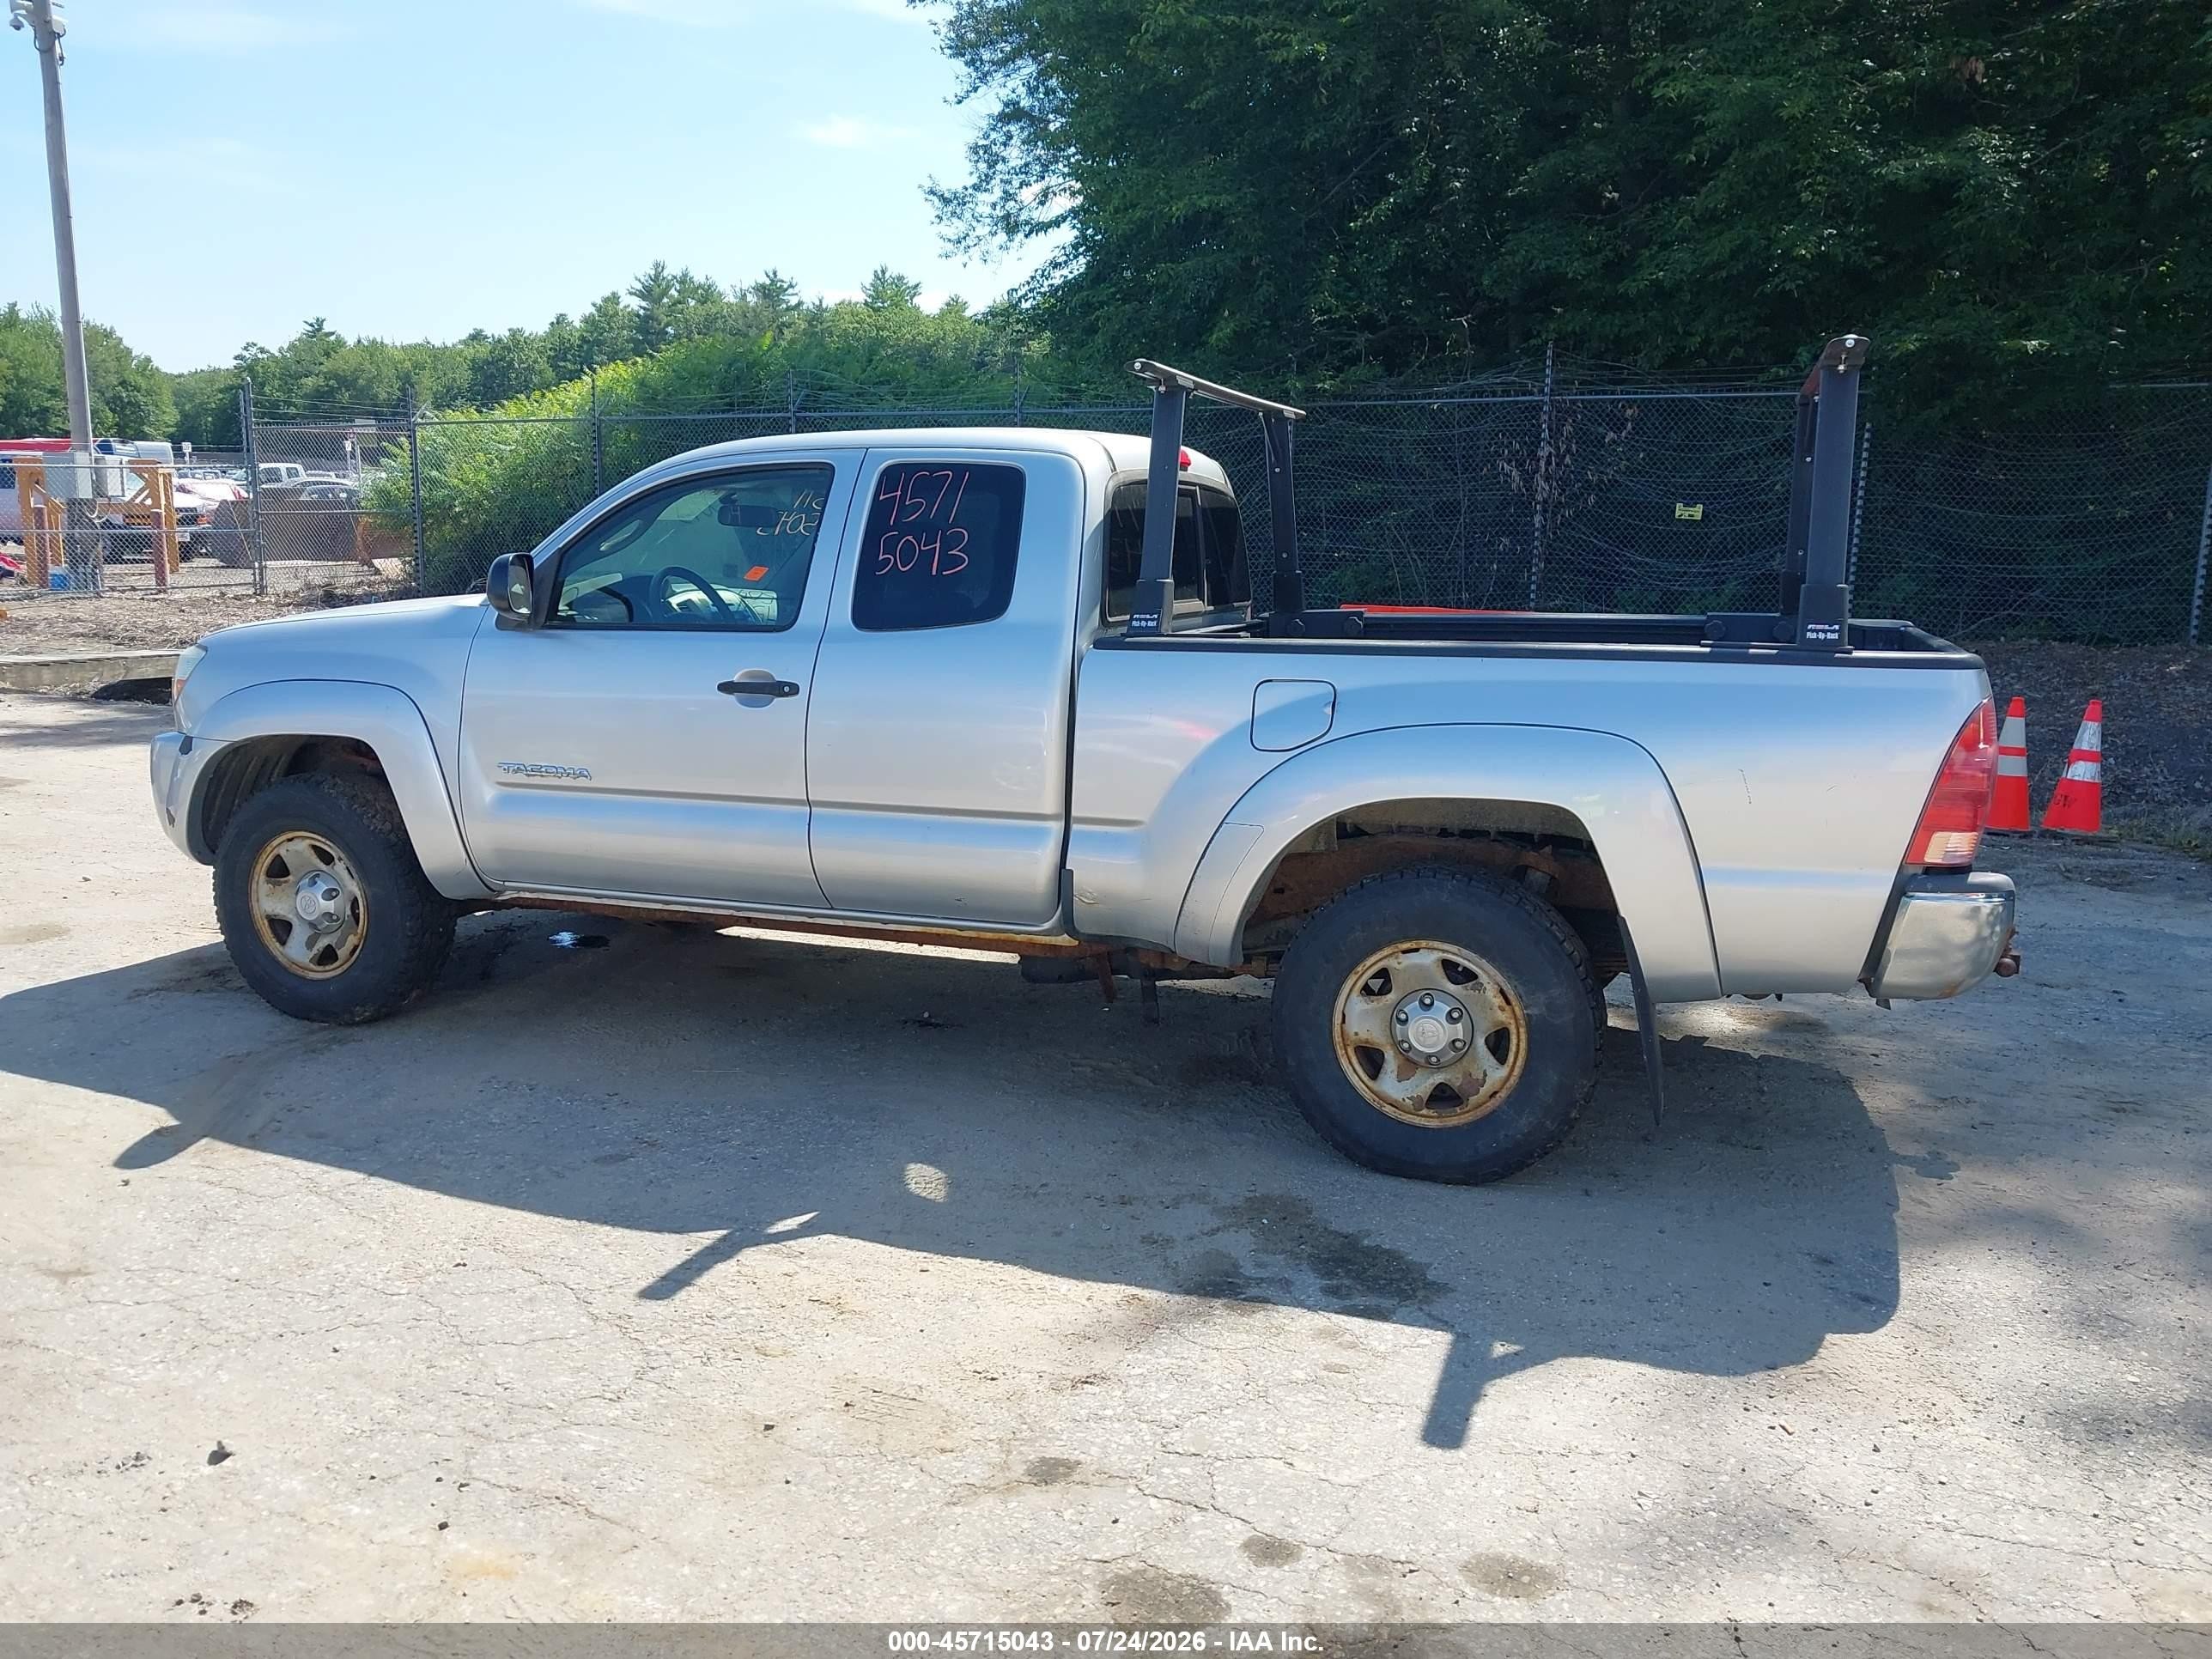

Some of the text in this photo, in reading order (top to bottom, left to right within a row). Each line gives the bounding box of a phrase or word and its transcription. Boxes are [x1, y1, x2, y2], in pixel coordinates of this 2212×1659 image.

[878, 471, 969, 526] 4571
[875, 527, 969, 576] 5043
[497, 762, 592, 781] TACOMA
